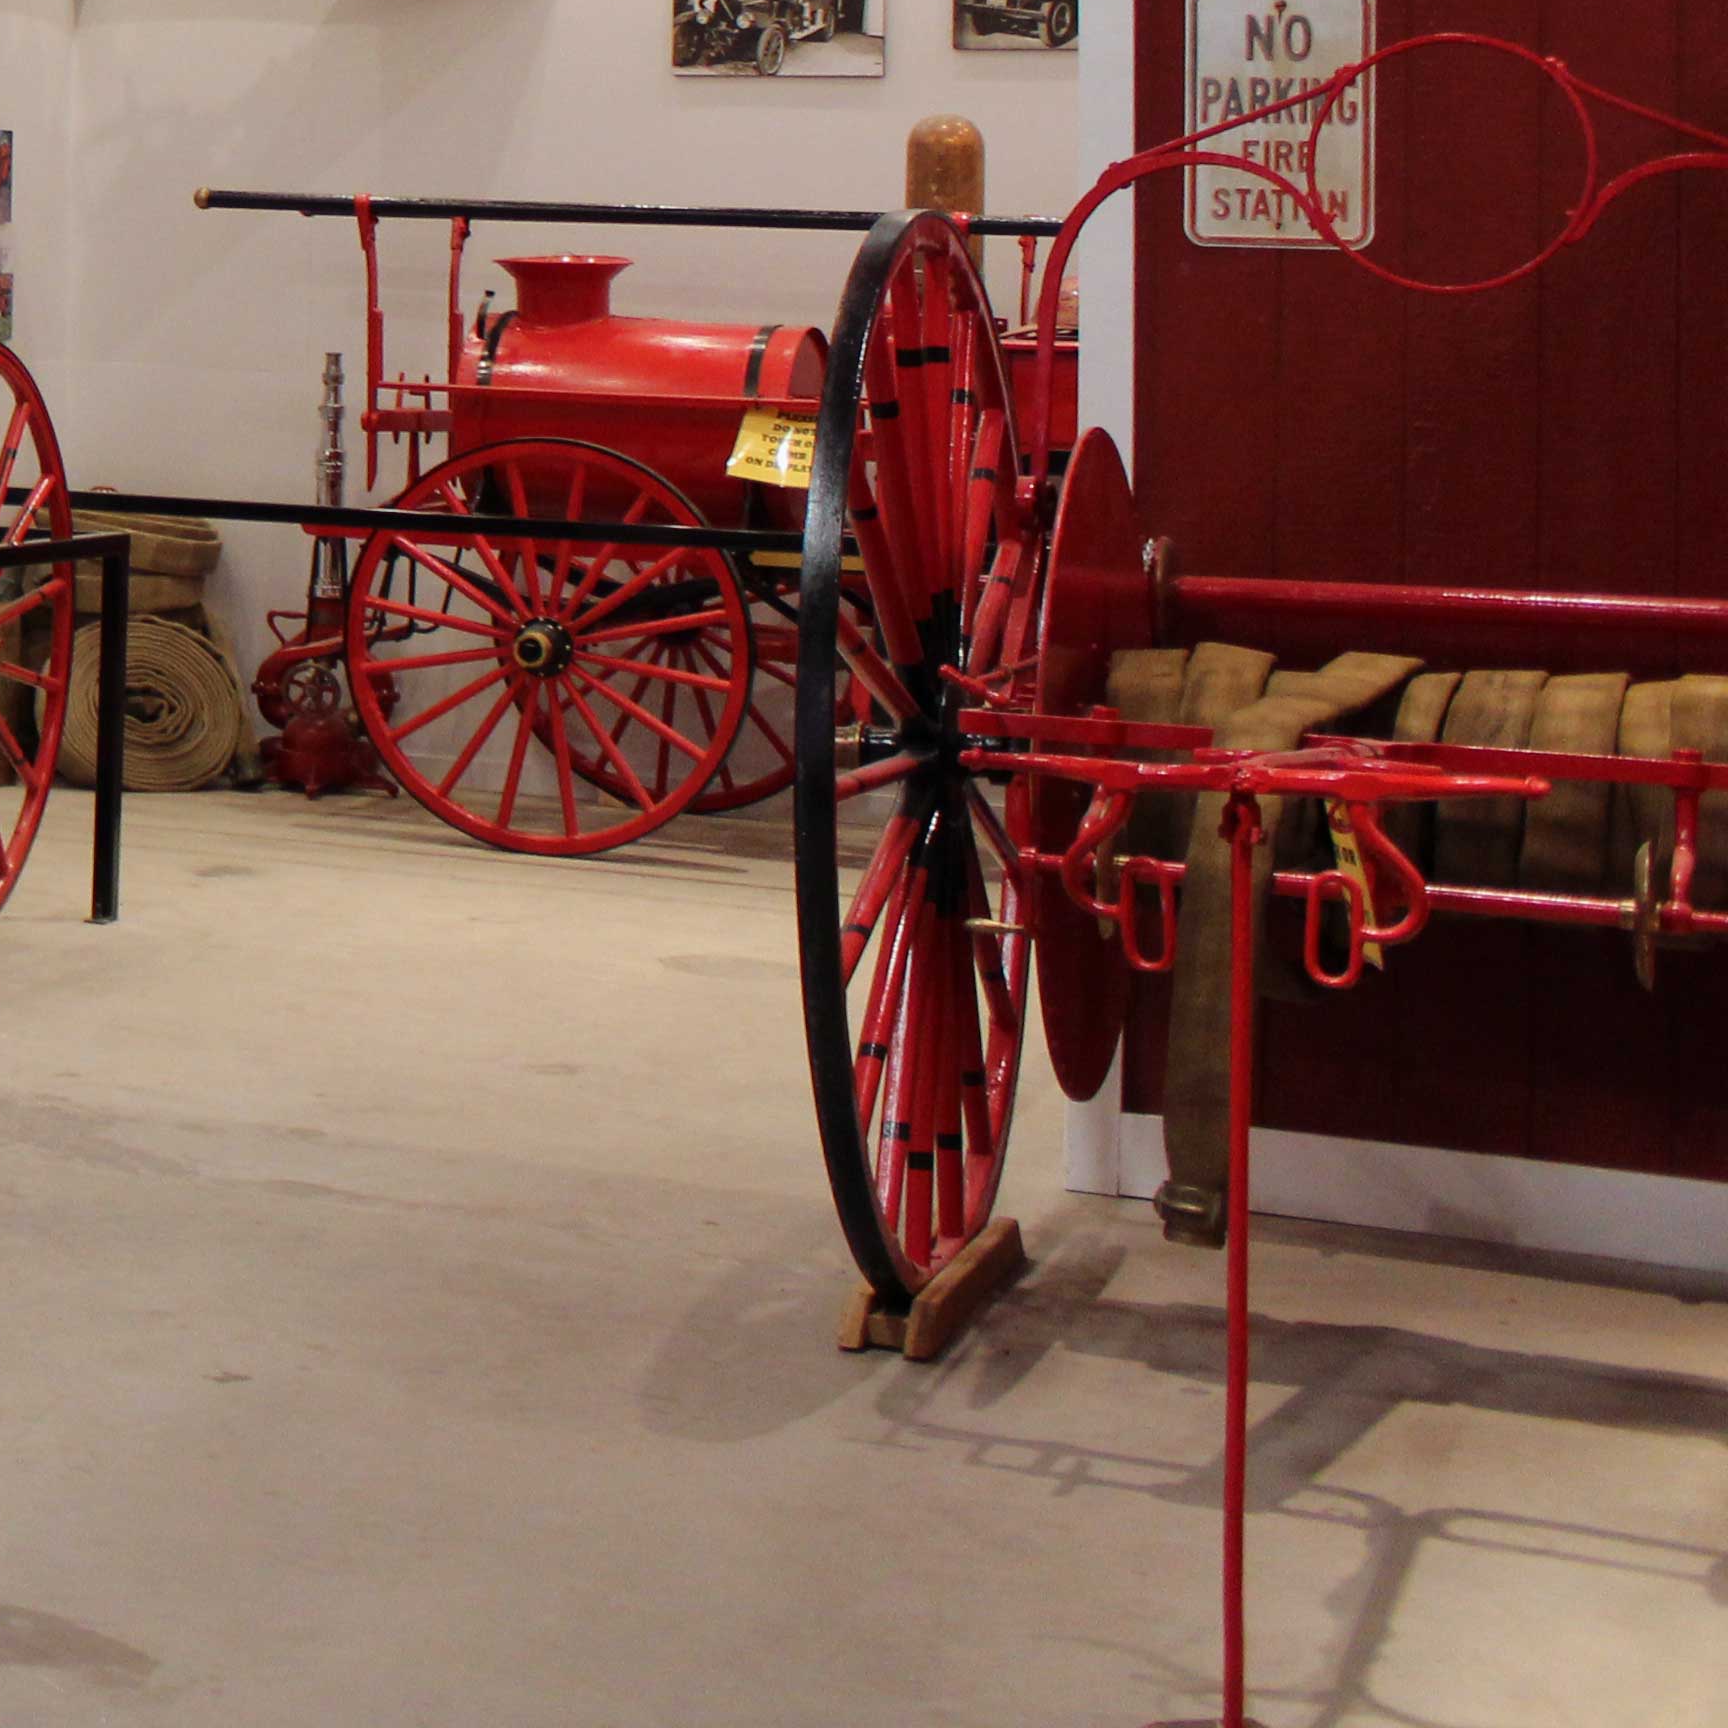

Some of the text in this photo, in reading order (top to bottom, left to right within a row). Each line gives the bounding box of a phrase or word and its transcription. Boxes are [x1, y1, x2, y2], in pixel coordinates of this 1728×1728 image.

[1245, 13, 1312, 62] NO
[1200, 76, 1359, 125] PARKING
[1212, 187, 1349, 223] STATIN
